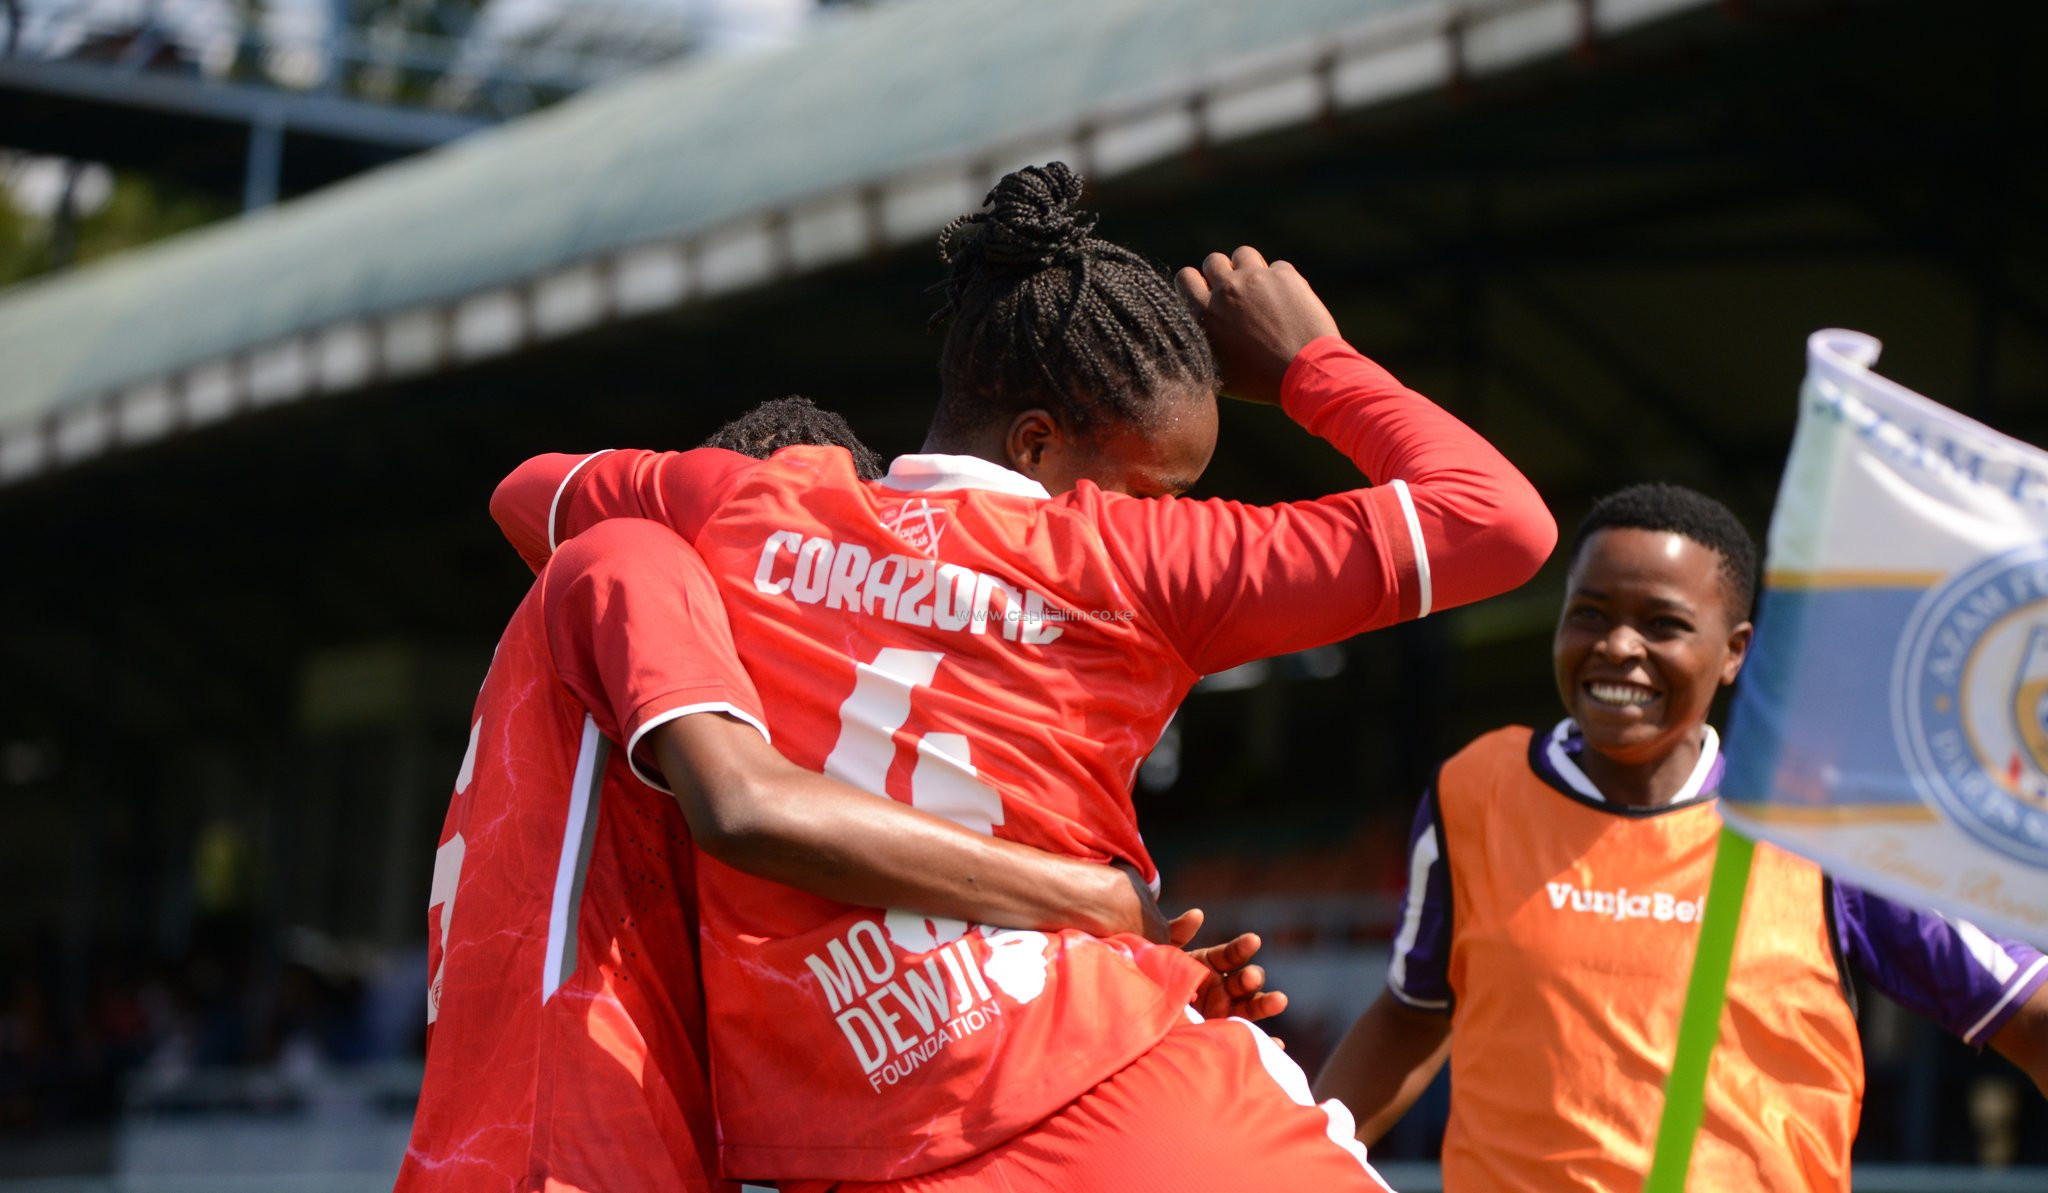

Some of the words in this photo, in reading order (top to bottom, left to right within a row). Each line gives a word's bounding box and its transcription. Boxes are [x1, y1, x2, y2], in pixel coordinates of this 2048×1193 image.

[754, 530, 1065, 645] CORAZONE
[804, 920, 895, 1013] MO
[835, 939, 992, 1075] DEWJI
[868, 1000, 1002, 1094] FOUNDATION
